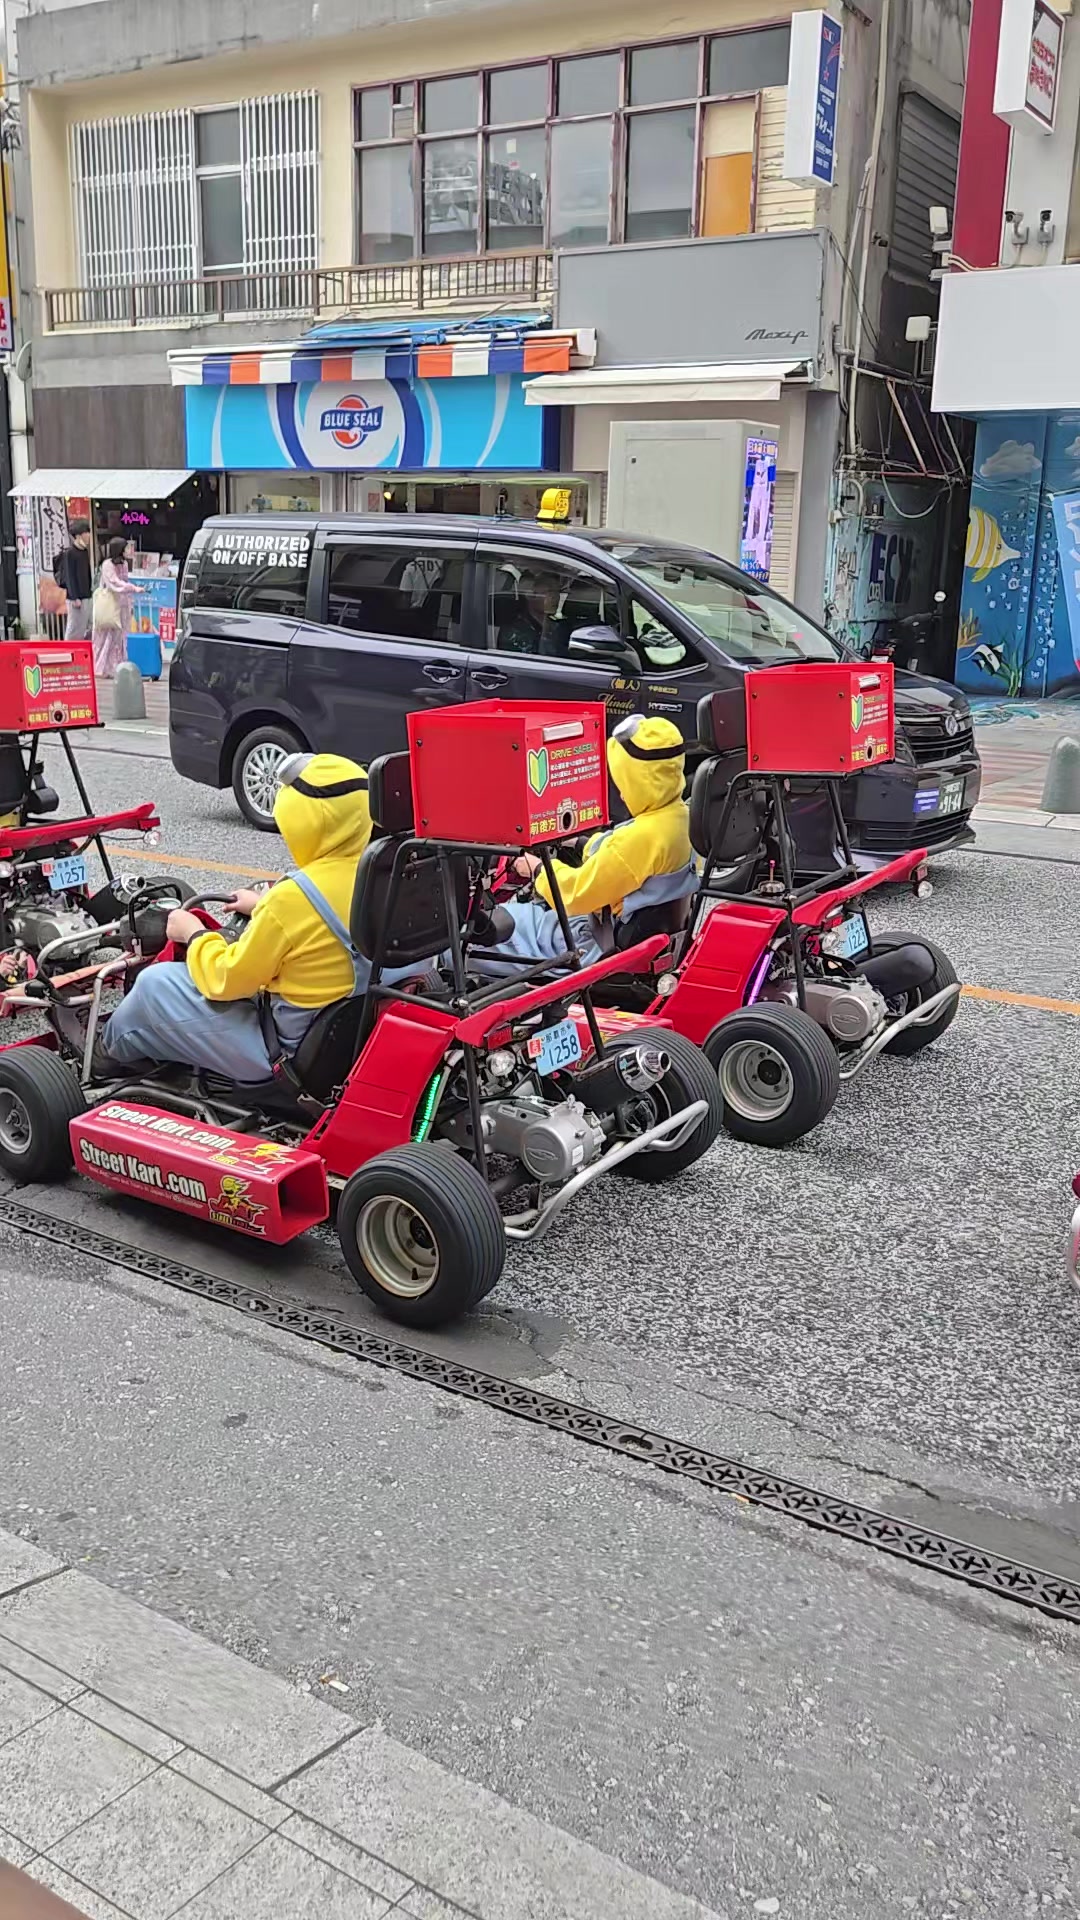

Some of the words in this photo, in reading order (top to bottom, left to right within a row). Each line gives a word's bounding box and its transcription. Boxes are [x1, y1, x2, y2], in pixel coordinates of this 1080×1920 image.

[324, 412, 350, 427] BLUE
[353, 412, 379, 427] SEAL
[214, 534, 310, 552] AUTHORIZED
[212, 549, 266, 567] ON/OFF
[267, 552, 308, 568] BASE
[551, 748, 572, 760] DRIVE
[530, 818, 556, 836] 前後方
[60, 865, 85, 885] 1257
[549, 1034, 578, 1066] 1258
[98, 1105, 148, 1126] Street
[79, 1138, 127, 1176] Street
